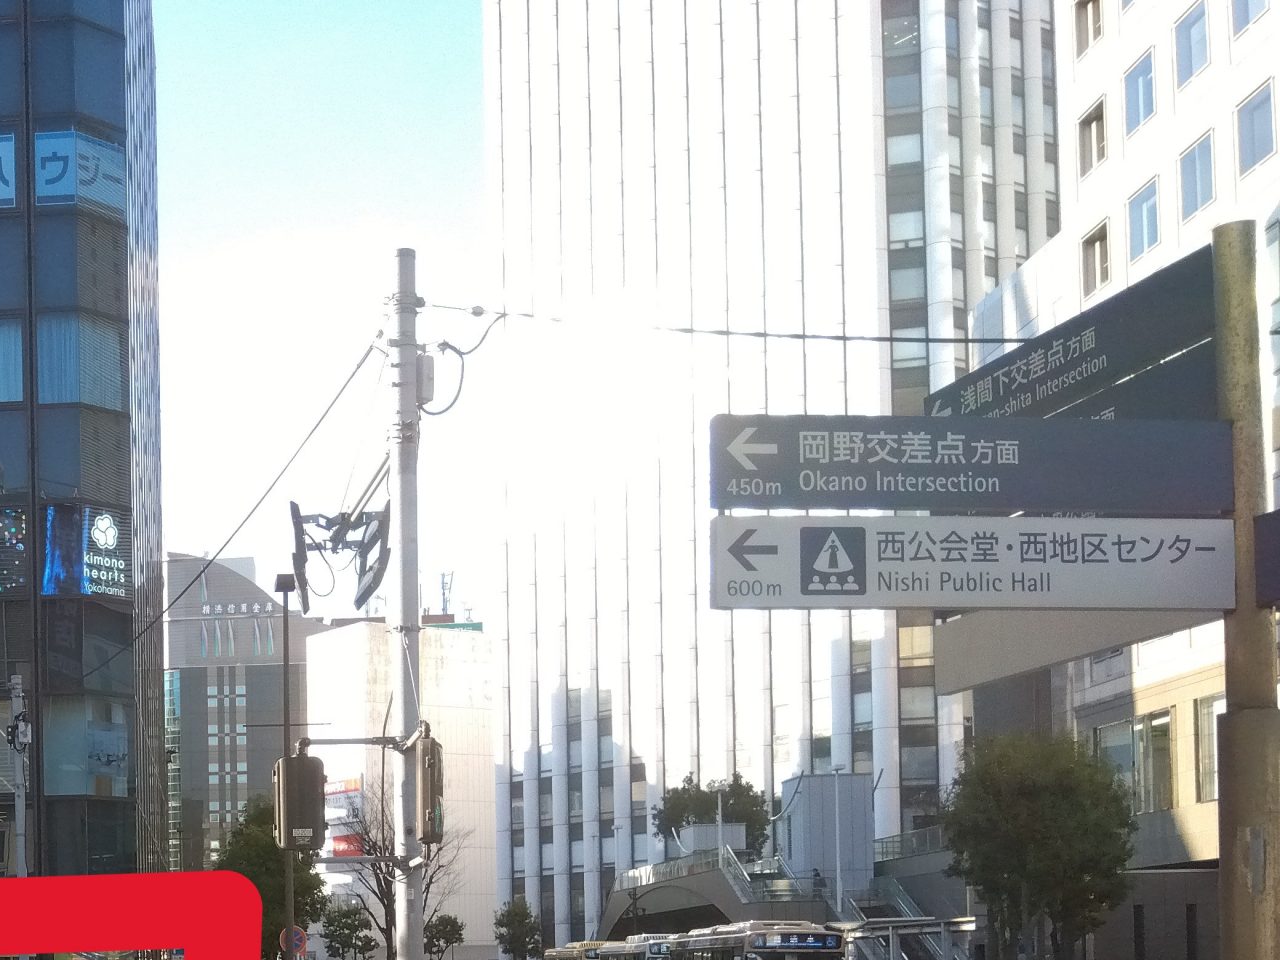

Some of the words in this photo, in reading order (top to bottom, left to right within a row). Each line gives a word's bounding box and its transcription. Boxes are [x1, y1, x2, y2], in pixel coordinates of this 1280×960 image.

[960, 326, 1097, 415] 浅間下交差点方面
[982, 385, 1032, 418] en-shita
[1035, 352, 1108, 401] Intersection
[799, 431, 1020, 465] 岡野交差点方面
[726, 477, 783, 496] 450m
[799, 470, 867, 493] Okano
[876, 470, 1001, 493] Intersection
[876, 530, 1217, 565] 西公会堂・西地区センター
[83, 551, 125, 569] kimono
[83, 565, 125, 583] hearts
[877, 571, 931, 593] Nishi
[940, 571, 1004, 593] Public
[1011, 571, 1052, 593] Hall
[84, 581, 126, 597] Yokohama
[726, 579, 783, 597] 600m
